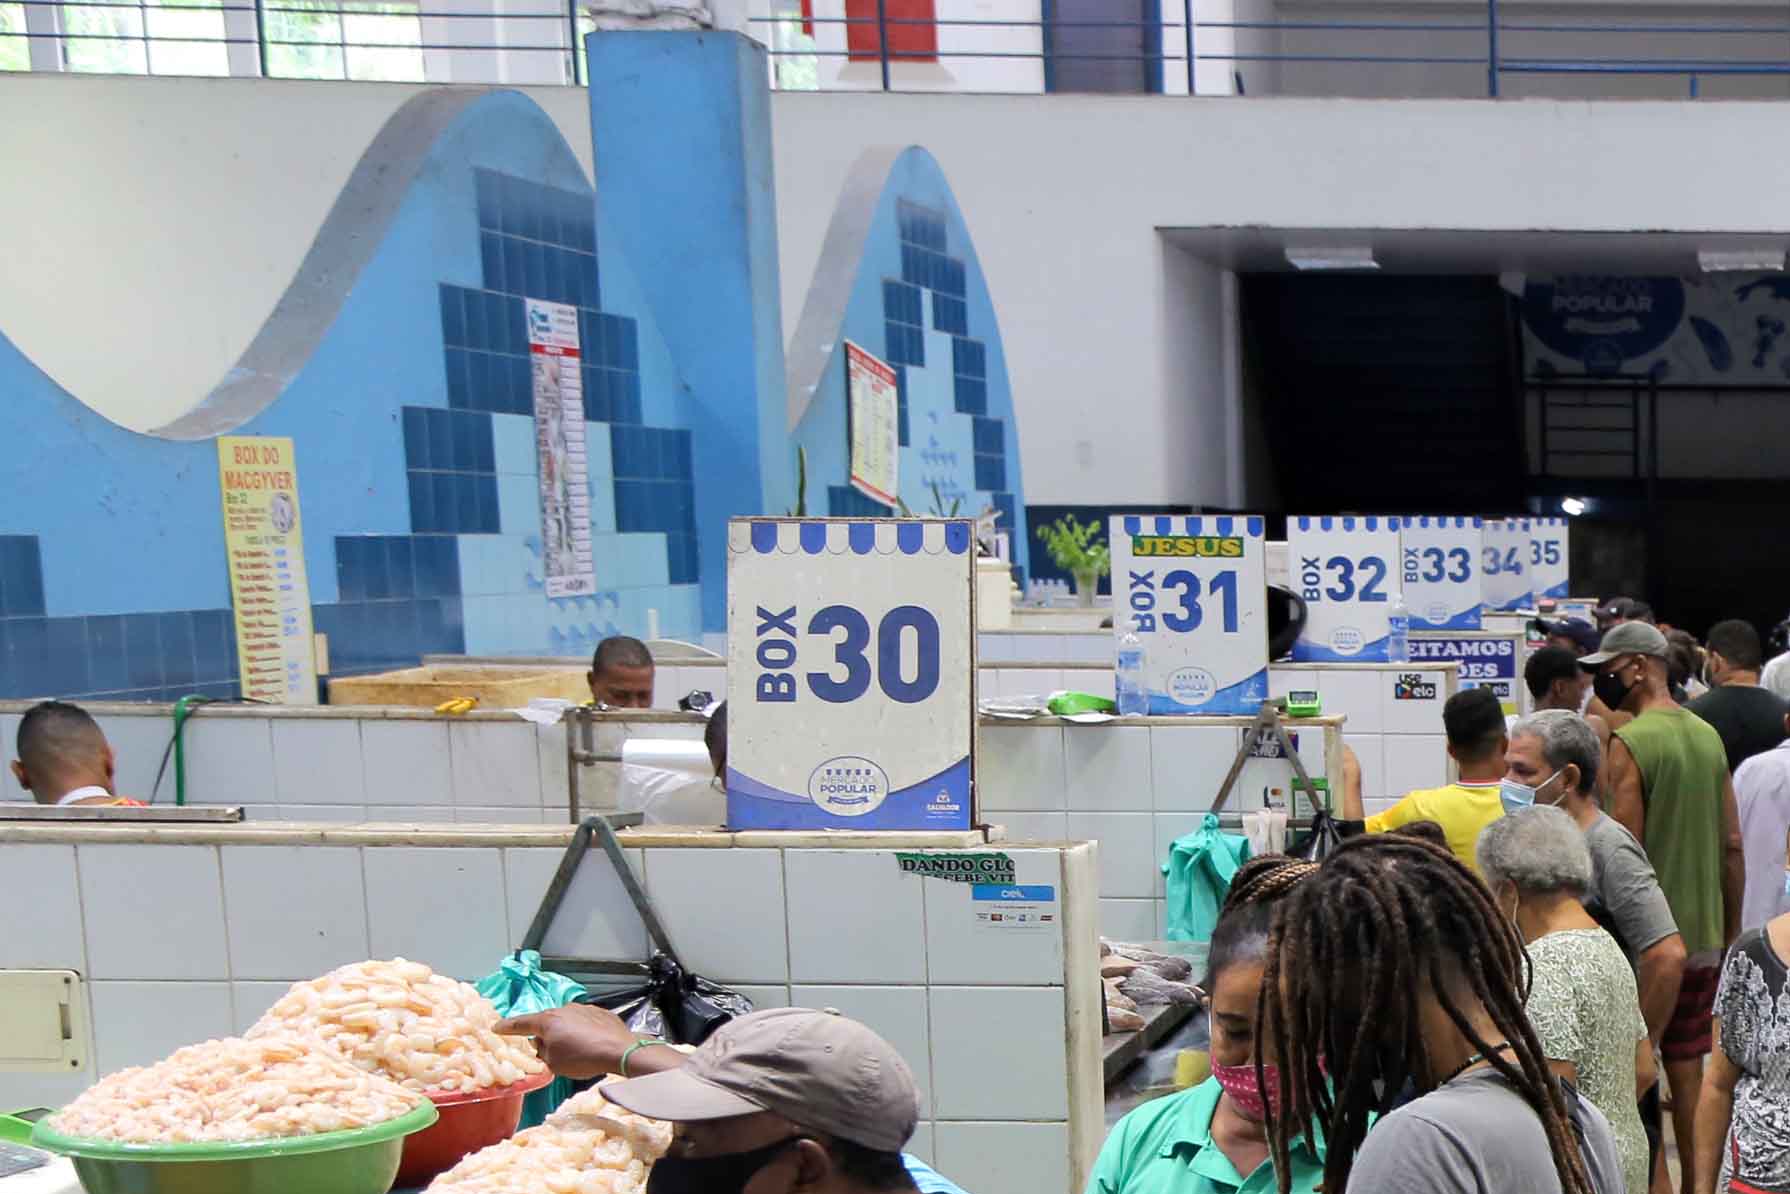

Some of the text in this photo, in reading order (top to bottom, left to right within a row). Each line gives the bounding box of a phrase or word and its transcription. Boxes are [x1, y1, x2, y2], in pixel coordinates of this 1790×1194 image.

[1552, 294, 1654, 313] POPULAR
[1133, 538, 1243, 557] JESUS
[1481, 546, 1523, 576] 34
[1530, 539, 1561, 566] 35
[1403, 547, 1471, 583] BOX 33
[1302, 556, 1388, 602] BOX 32
[1128, 569, 1239, 633] BOX 31
[756, 604, 940, 704] BOX 30
[1408, 641, 1512, 657] EITAMOS
[820, 784, 877, 794] POPULAR
[902, 859, 974, 872] DANDO
